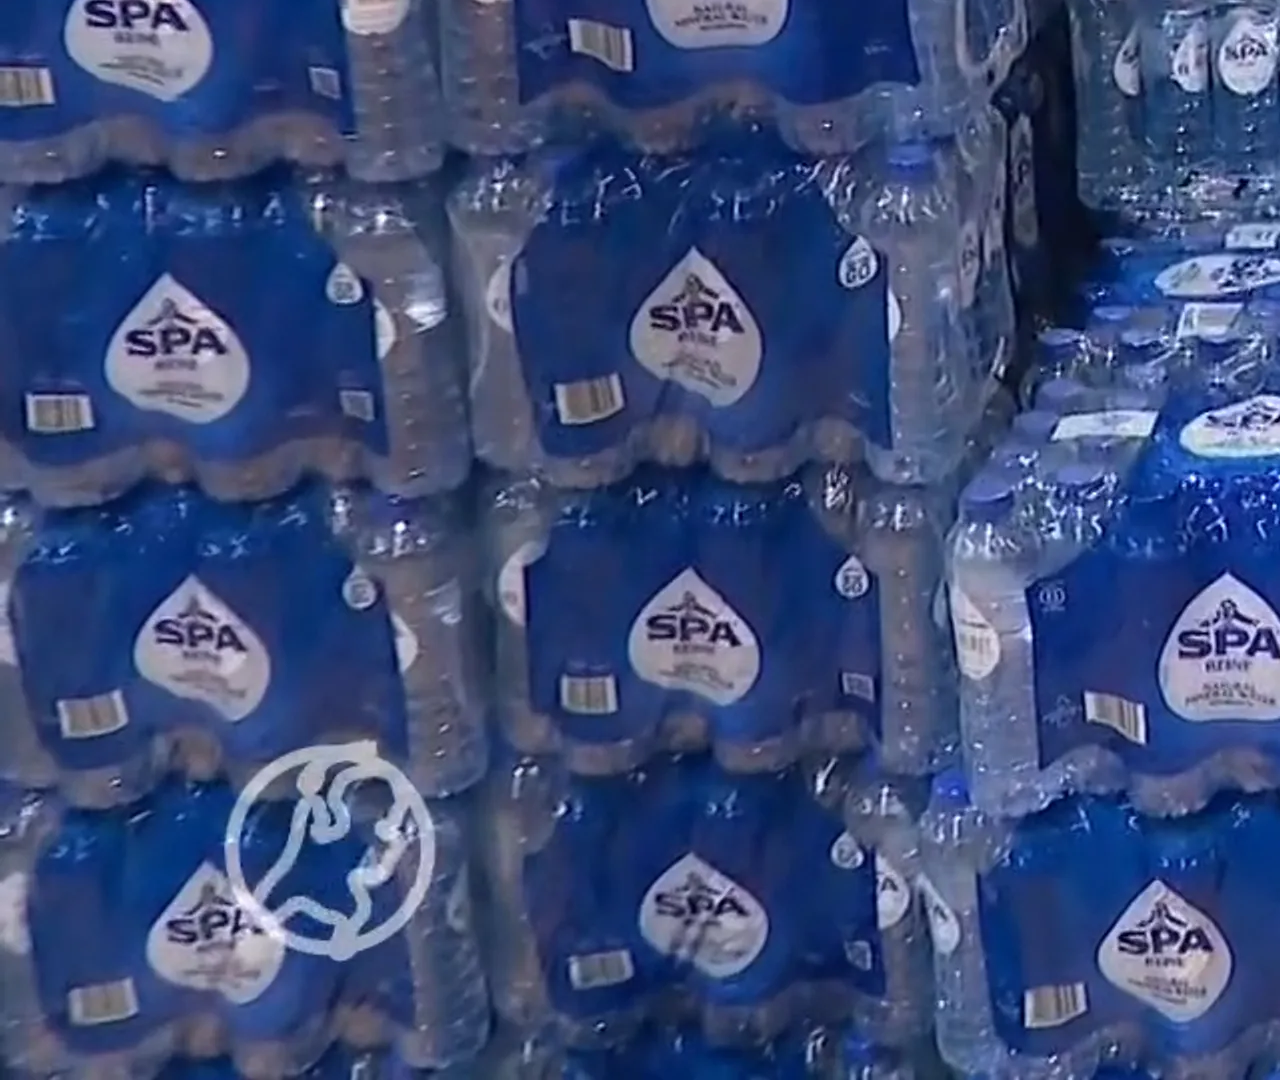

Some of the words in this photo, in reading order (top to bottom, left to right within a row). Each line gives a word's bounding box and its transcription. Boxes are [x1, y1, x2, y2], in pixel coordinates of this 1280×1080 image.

[648, 300, 746, 334] SPA
[124, 326, 230, 357] SPA
[153, 618, 248, 654] SPA
[646, 613, 743, 648] SPA
[654, 886, 750, 919] SPA
[1117, 926, 1214, 956] SPA
